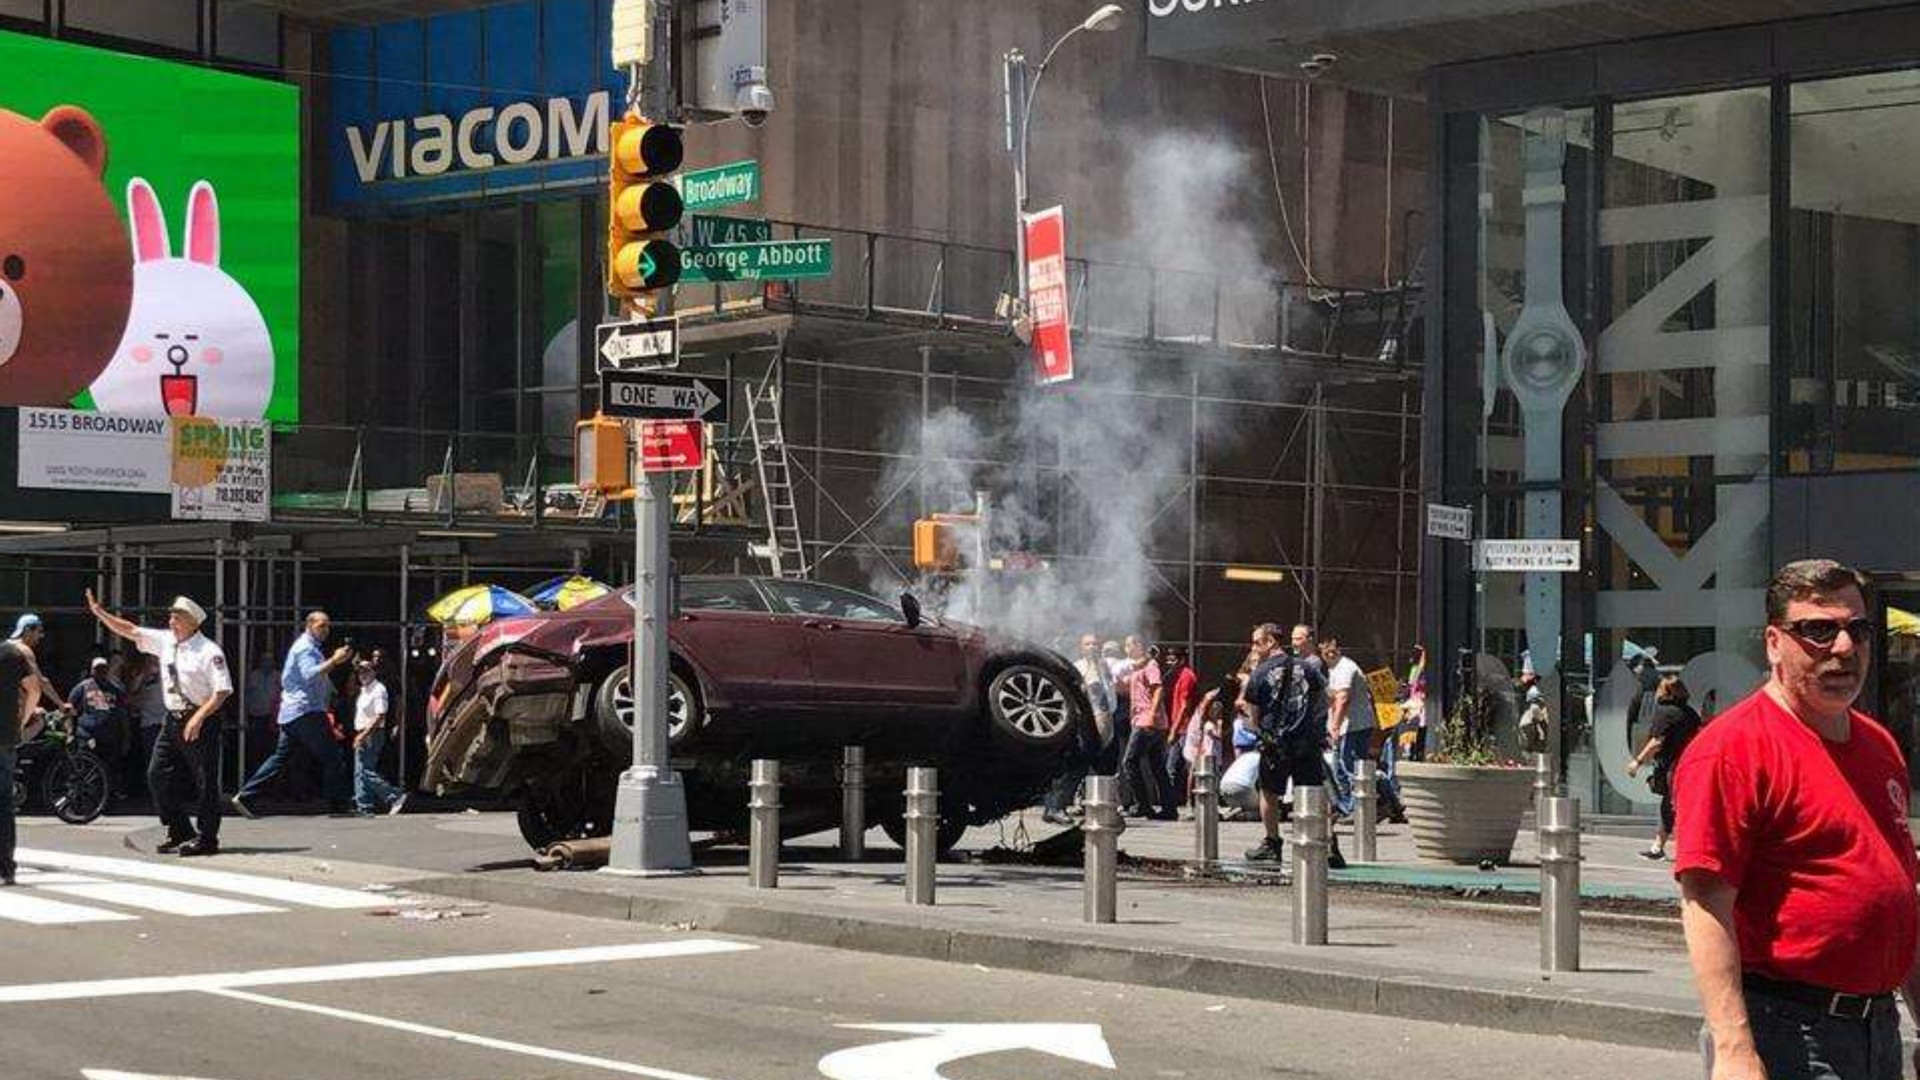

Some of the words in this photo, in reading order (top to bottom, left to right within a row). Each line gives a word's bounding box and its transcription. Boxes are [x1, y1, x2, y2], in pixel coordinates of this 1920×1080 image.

[685, 172, 754, 204] Broadway
[697, 219, 715, 246] W
[724, 223, 748, 243] 45
[756, 225, 769, 242] St
[680, 250, 750, 272] George
[758, 244, 822, 266] Abbott
[608, 338, 631, 357] ONE
[642, 333, 668, 353] WAY
[620, 385, 658, 405] ONE
[672, 388, 710, 408] WAY
[29, 413, 68, 430] 1515
[72, 415, 165, 434] BROADWAY
[180, 423, 266, 450] SPRING
